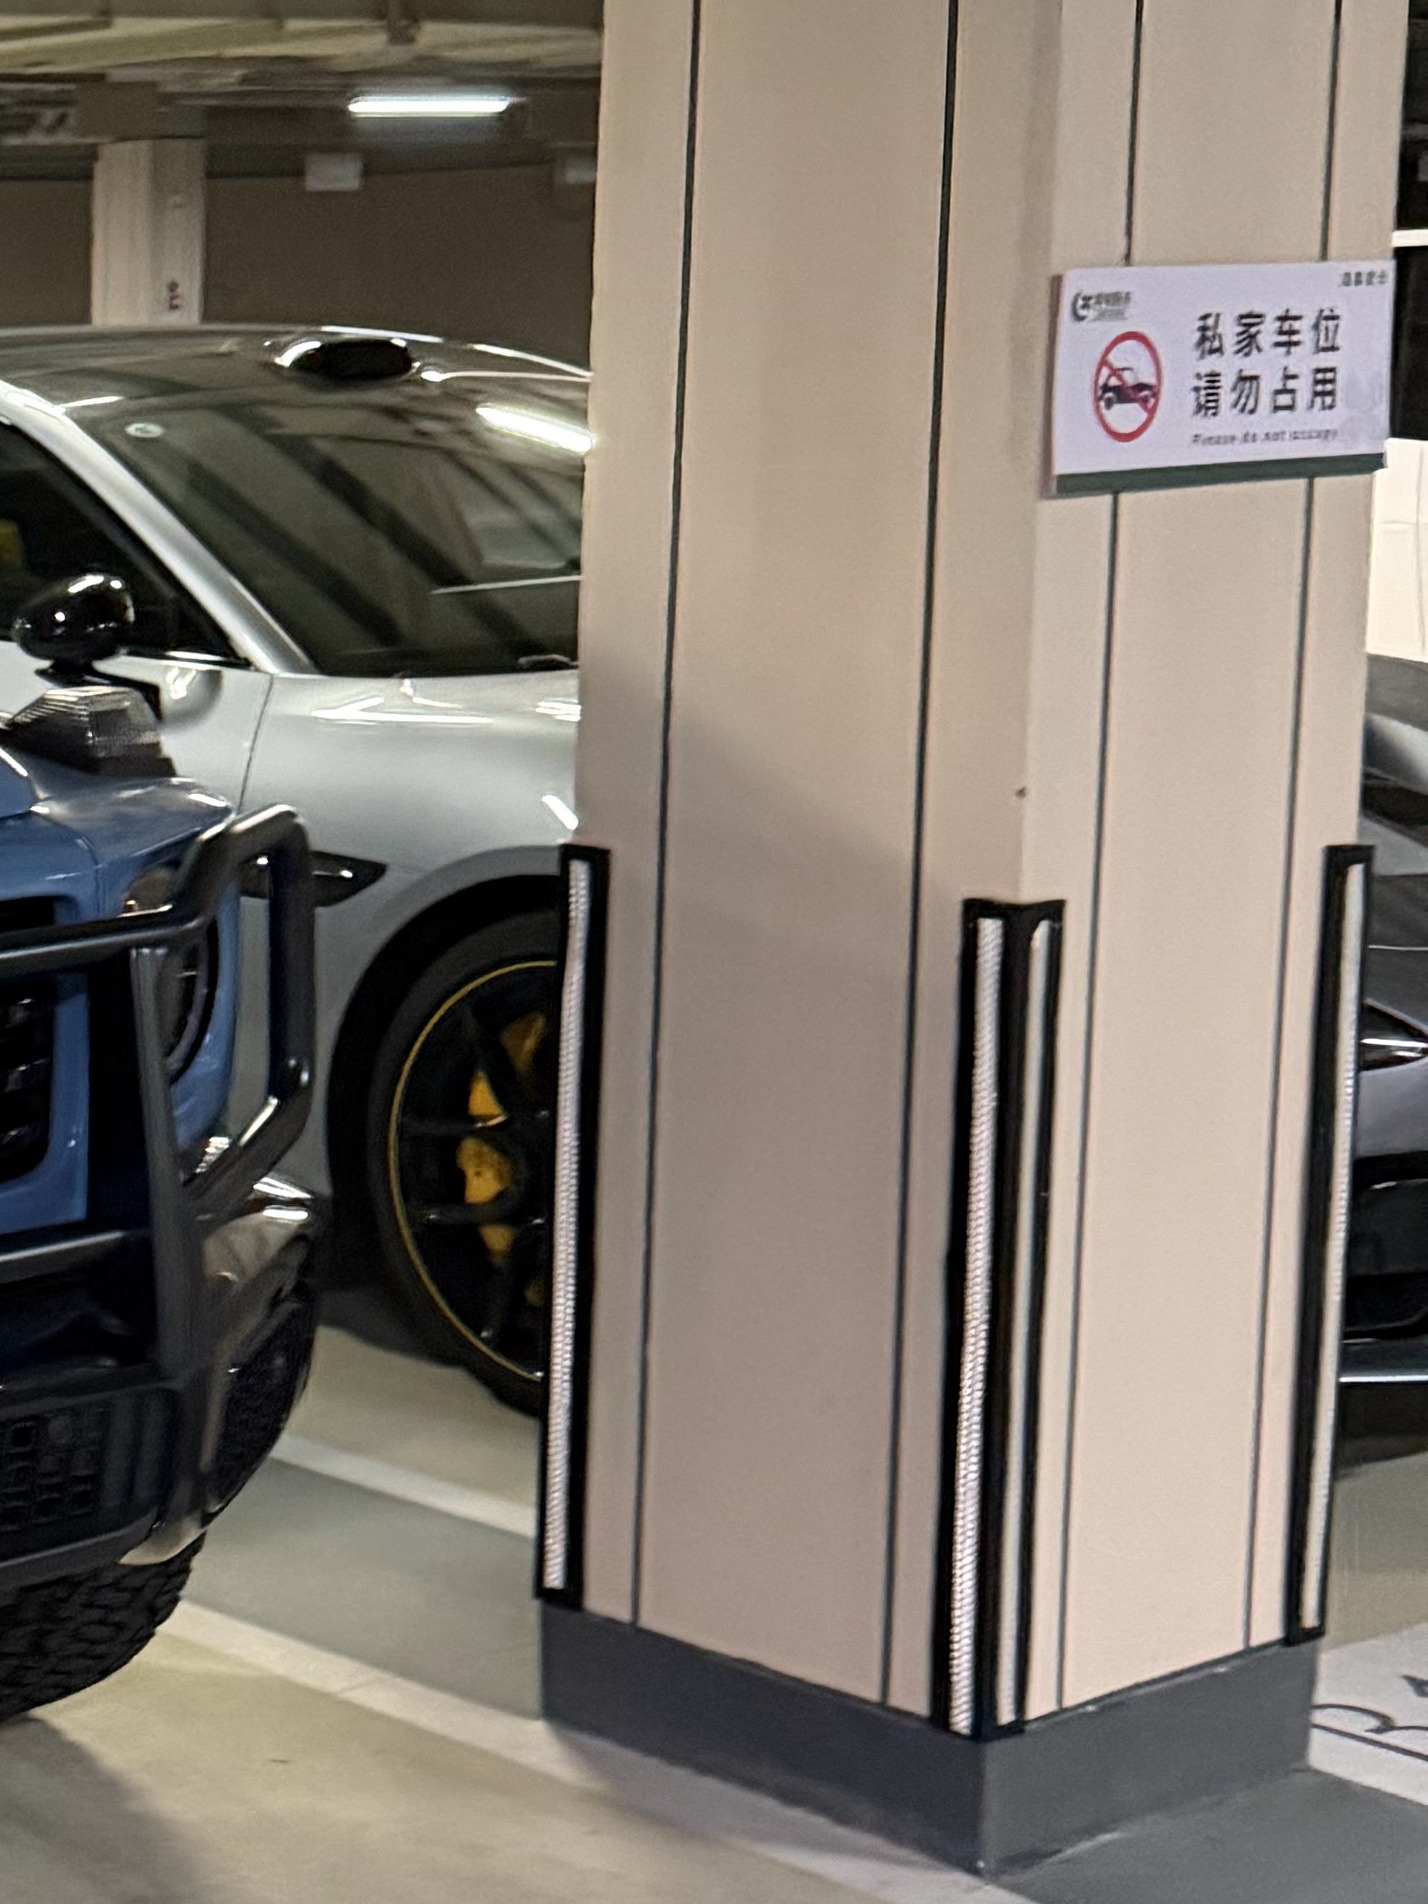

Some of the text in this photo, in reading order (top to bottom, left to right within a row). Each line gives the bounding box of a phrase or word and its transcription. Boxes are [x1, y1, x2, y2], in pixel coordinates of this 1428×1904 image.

[1193, 309, 1341, 359] 私家车位
[1191, 367, 1338, 417] 请勿占用
